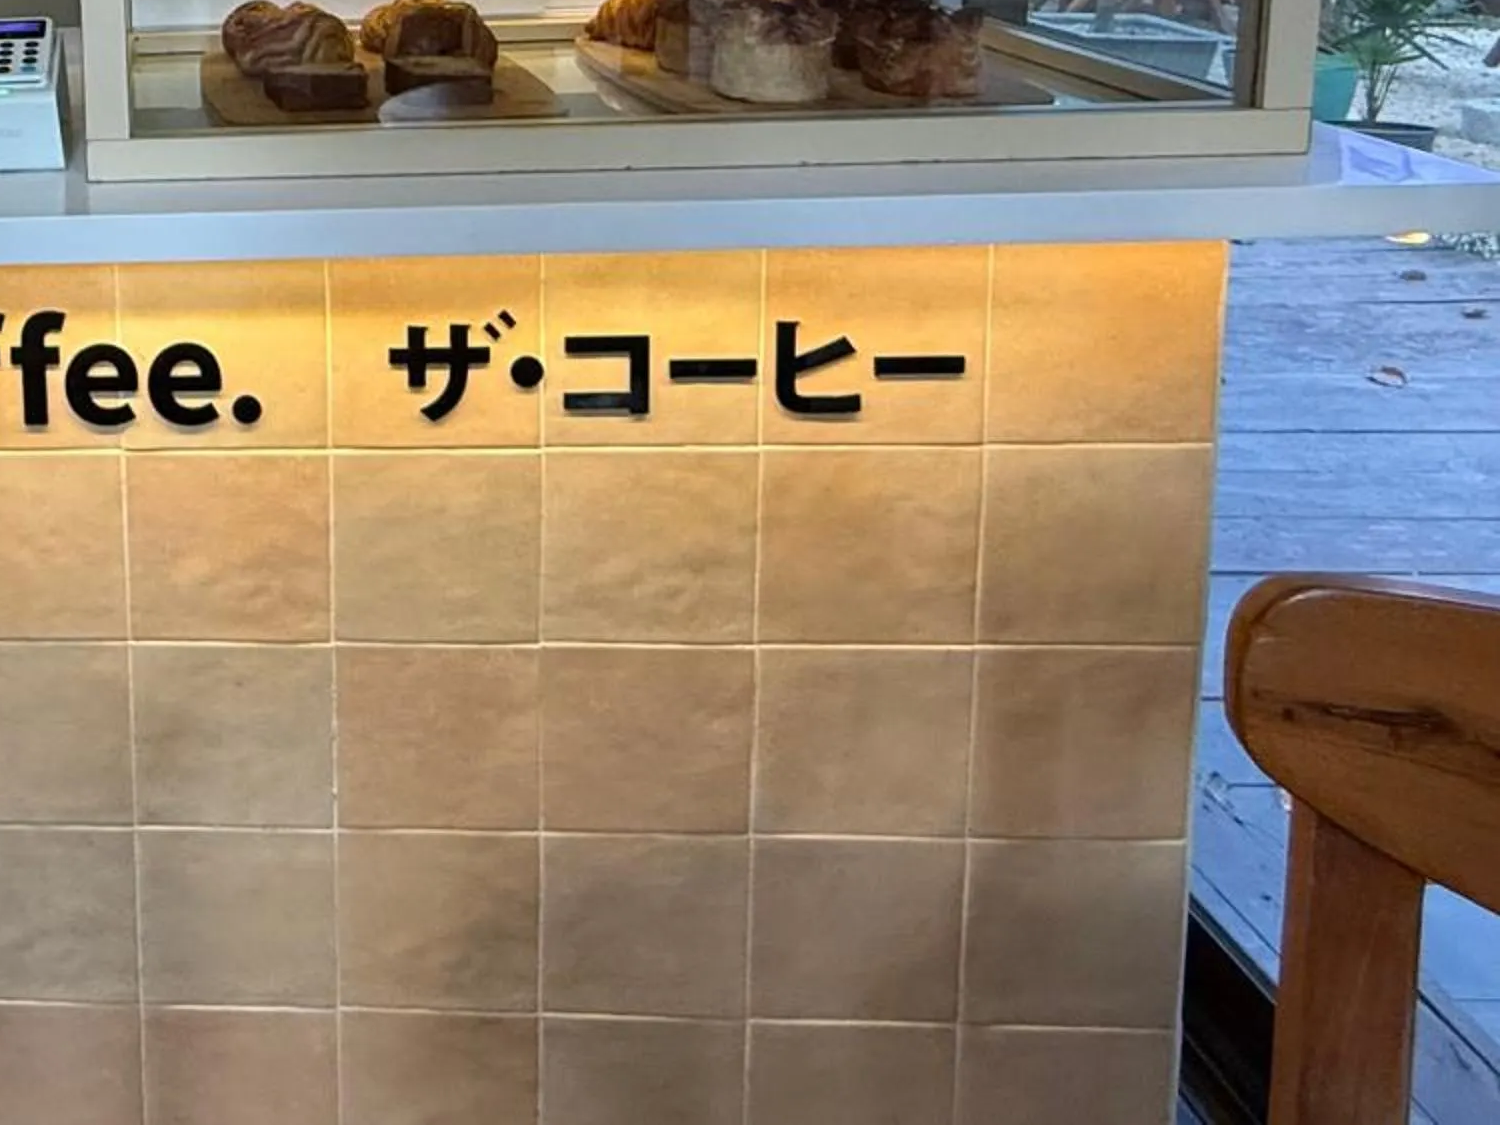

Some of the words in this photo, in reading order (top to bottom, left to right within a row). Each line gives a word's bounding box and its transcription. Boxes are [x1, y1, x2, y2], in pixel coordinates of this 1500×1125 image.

[388, 311, 966, 422] ザ・コーヒー
